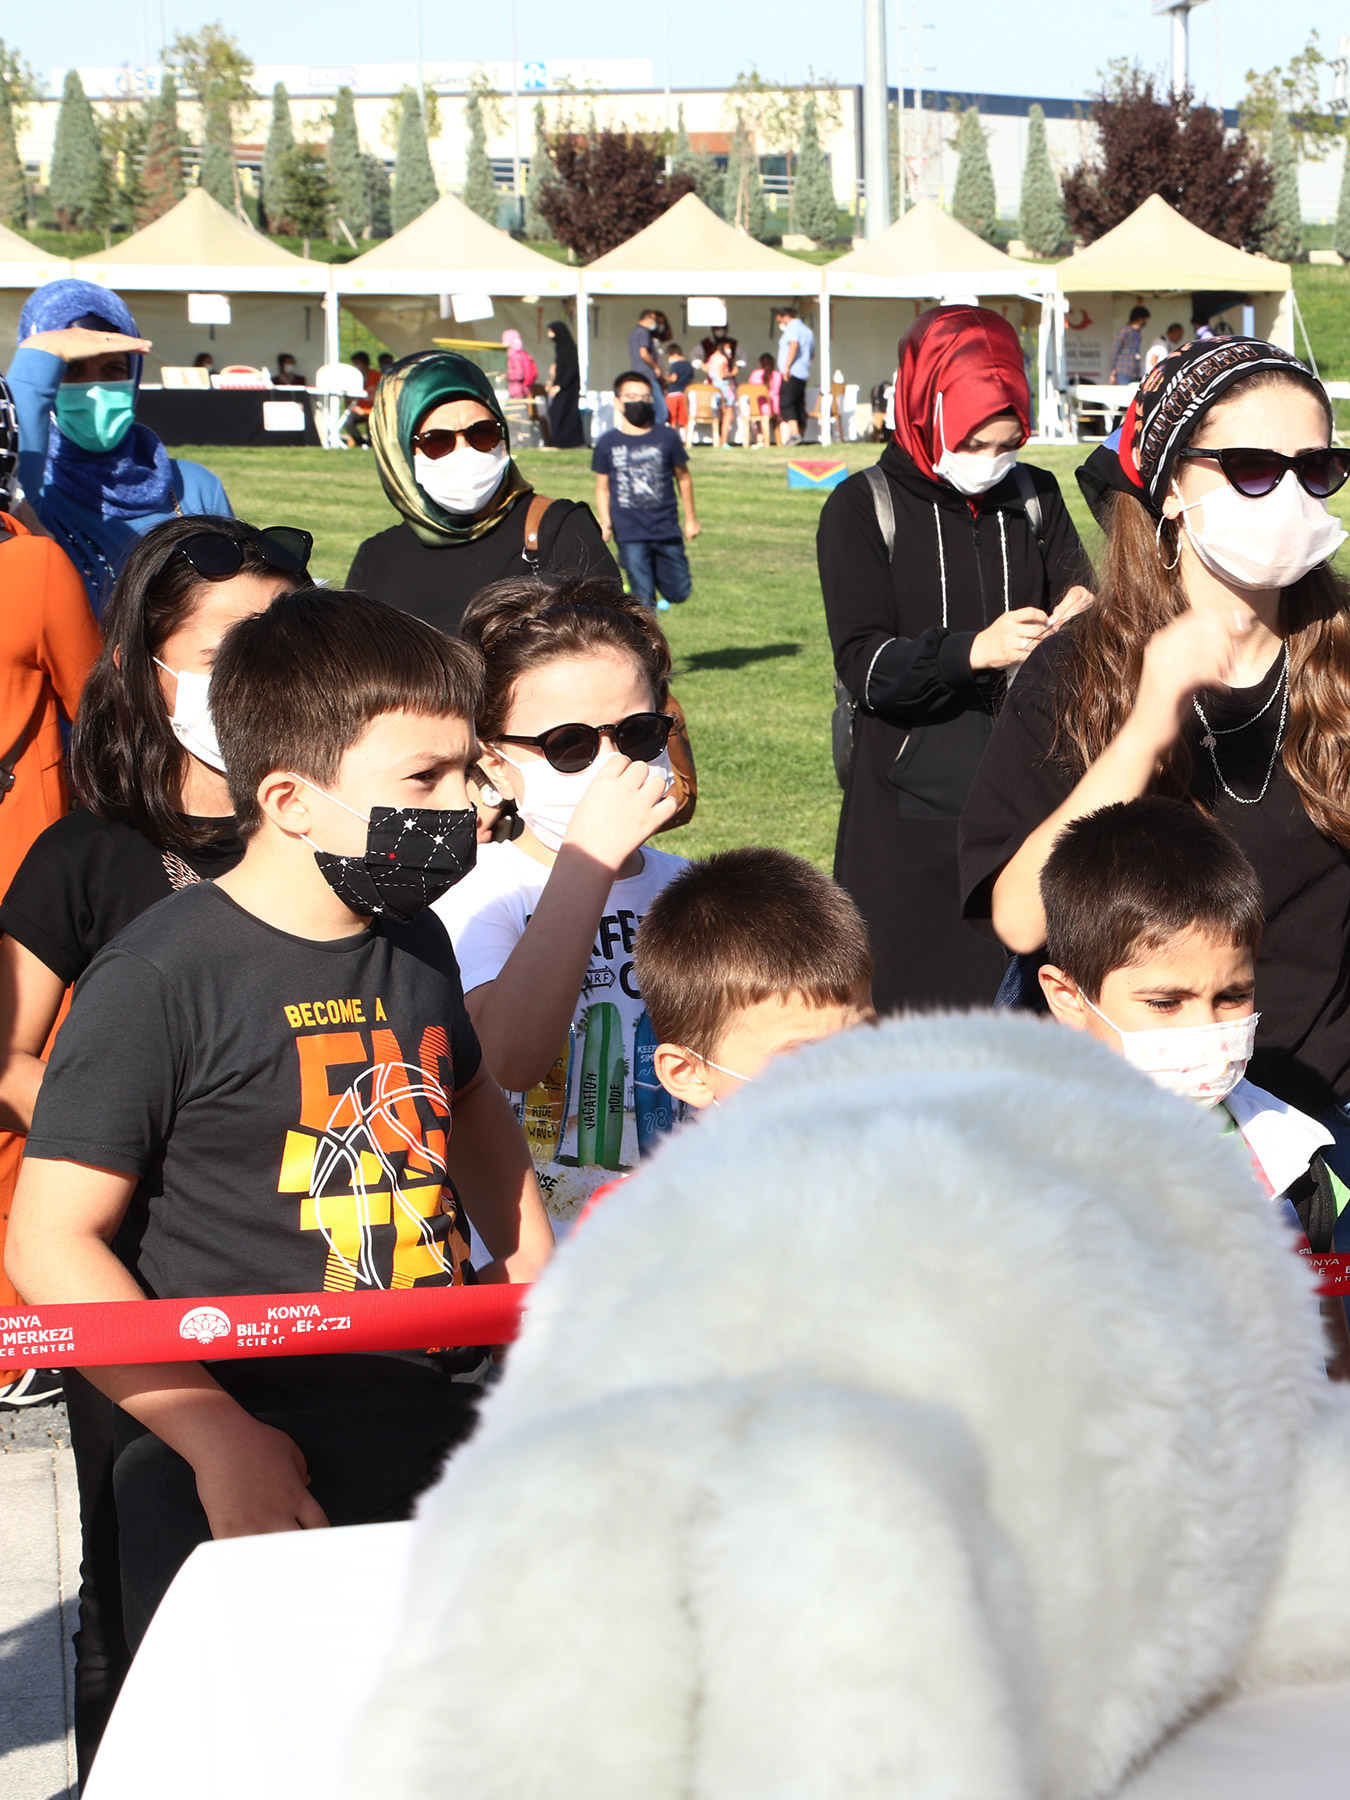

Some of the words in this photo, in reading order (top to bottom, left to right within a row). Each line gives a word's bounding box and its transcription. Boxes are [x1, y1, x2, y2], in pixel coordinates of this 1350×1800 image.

[284, 998, 366, 1028] BECOME
[375, 997, 387, 1021] A
[582, 1072, 598, 1131] VACATION
[609, 1083, 622, 1113] MODE
[532, 1105, 553, 1117] RIDE
[267, 1304, 321, 1320] KONYA
[22, 1342, 75, 1355] CENTER
